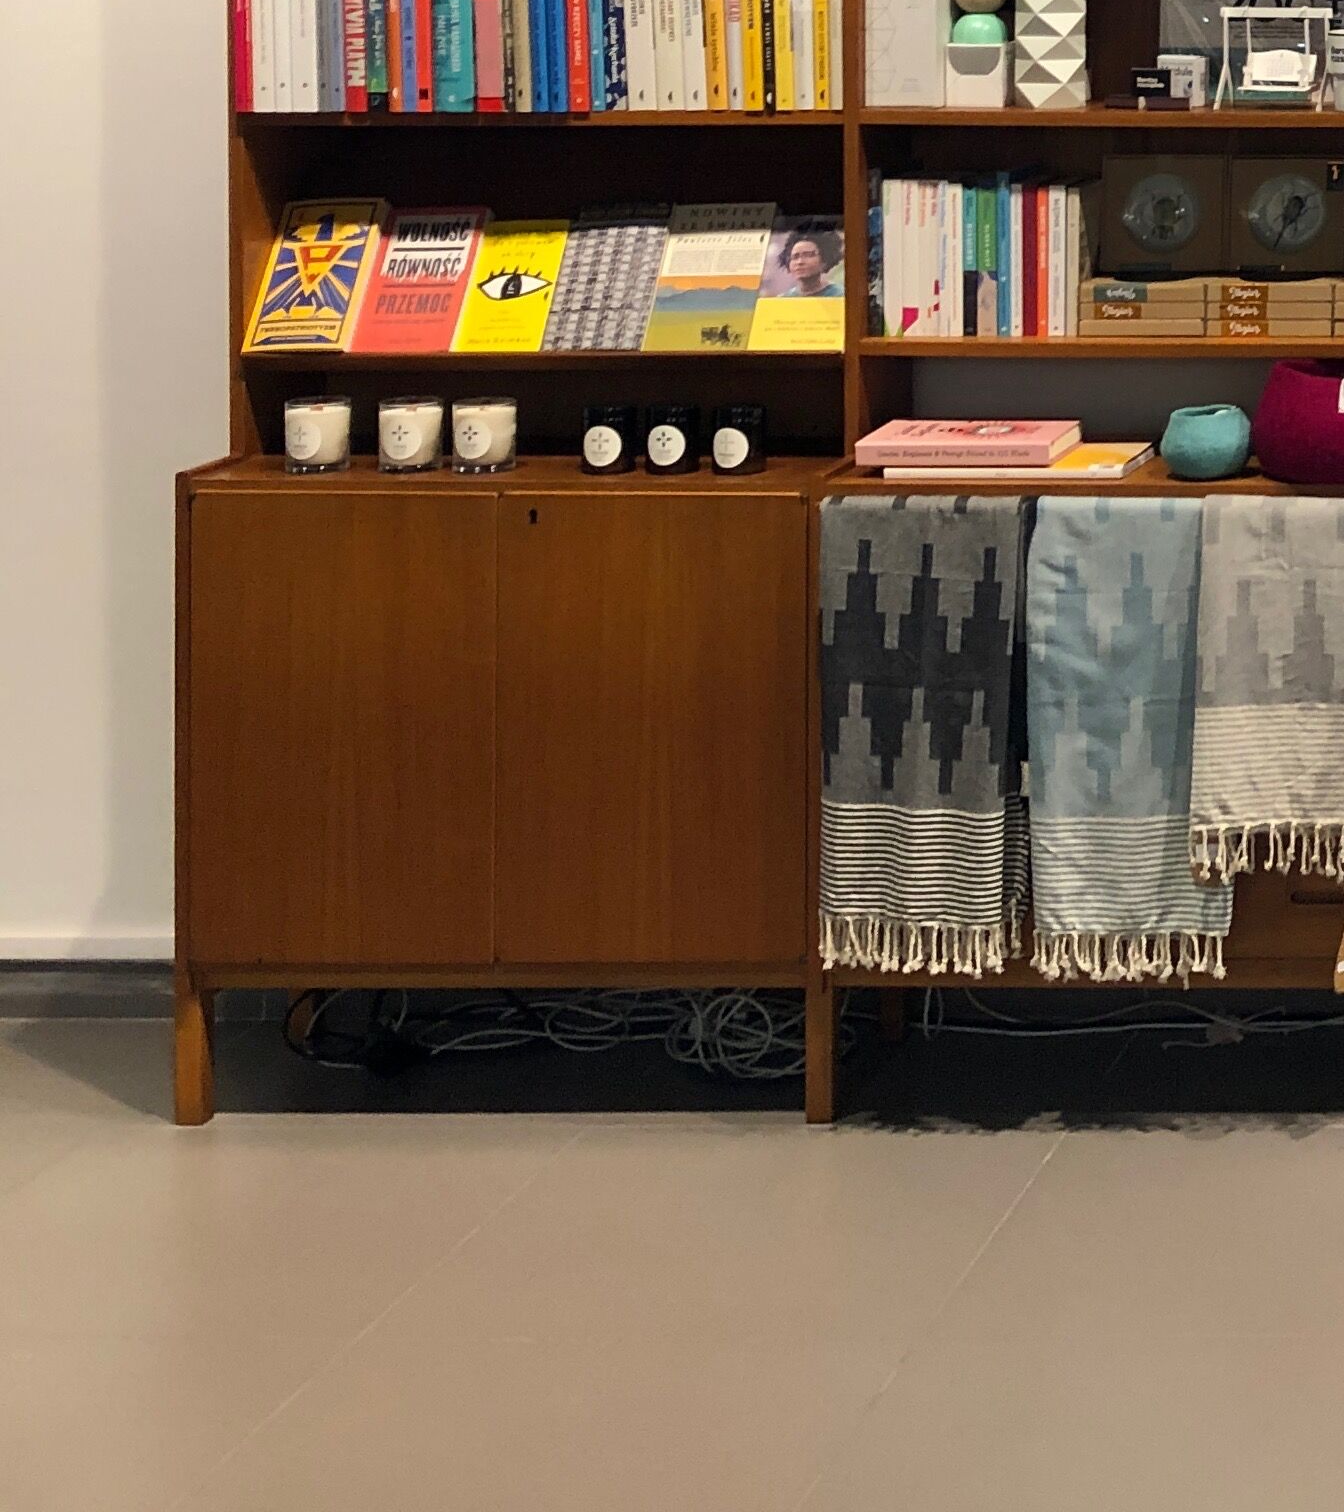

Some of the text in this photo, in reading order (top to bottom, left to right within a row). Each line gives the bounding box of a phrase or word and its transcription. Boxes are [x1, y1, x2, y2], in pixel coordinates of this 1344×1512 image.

[346, 38, 365, 87] PLATH
[690, 206, 766, 218] NOWINY
[396, 217, 471, 242] WOLNOŚĆ
[386, 252, 462, 279] RÓWNOŚĆ
[375, 293, 452, 315] PRZEMOC
